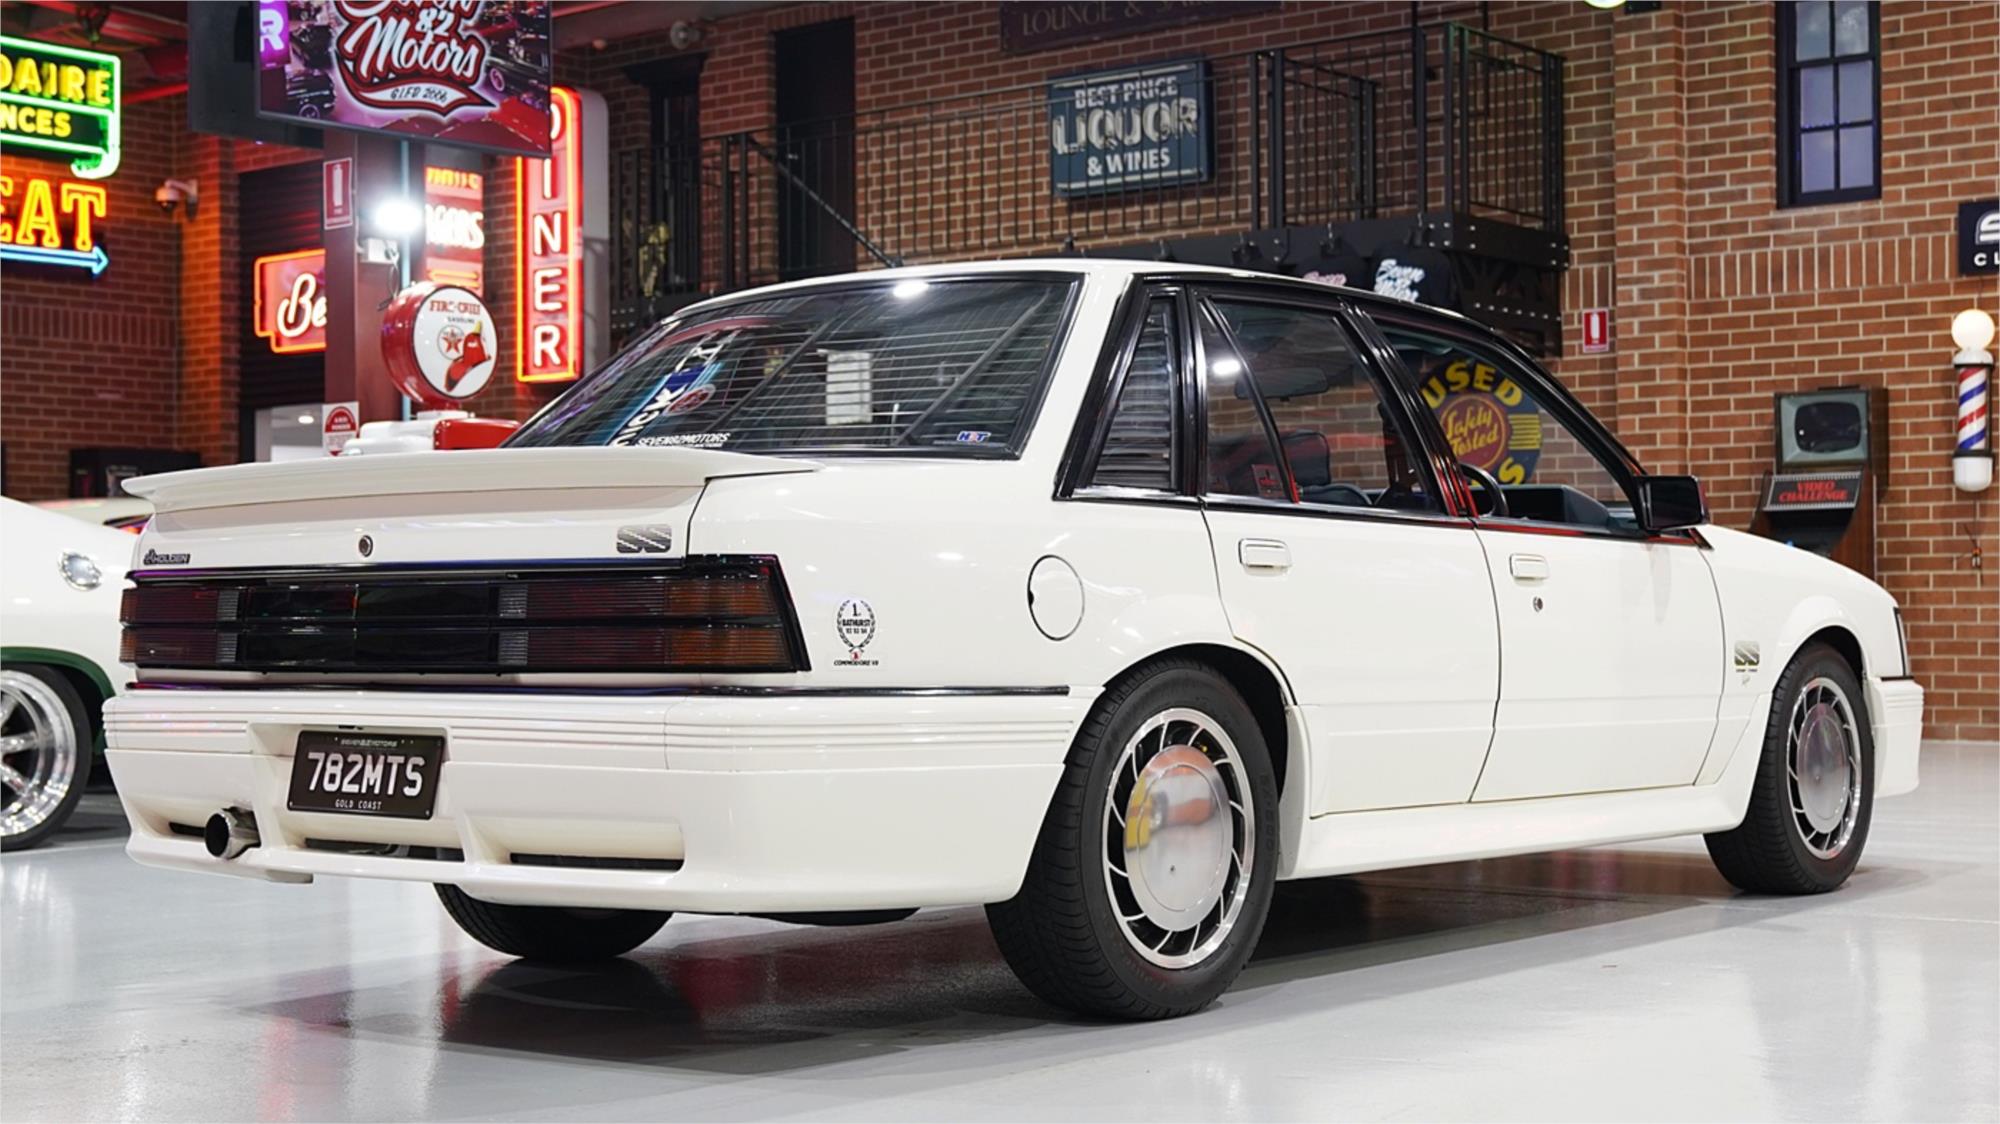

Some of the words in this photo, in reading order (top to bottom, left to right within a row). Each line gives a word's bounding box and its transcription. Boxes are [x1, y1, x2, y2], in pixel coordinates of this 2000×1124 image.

[415, 8, 455, 36] 82
[1022, 1, 1114, 37] LOUNGE
[343, 15, 479, 79] Motors
[1074, 84, 1120, 109] BEST
[1123, 76, 1178, 103] PRICE
[1052, 98, 1198, 154] LIQUOR
[1087, 157, 1103, 176] &
[1106, 147, 1170, 174] WINES
[1421, 362, 1523, 409] USED
[1446, 404, 1493, 440] Safety
[1451, 424, 1499, 456] Tested
[1778, 489, 1849, 503] CHALLENGE
[1796, 480, 1836, 493] VIDEO
[307, 751, 426, 797] 782MTS
[335, 799, 354, 809] GOLD
[358, 800, 383, 811] COAST
